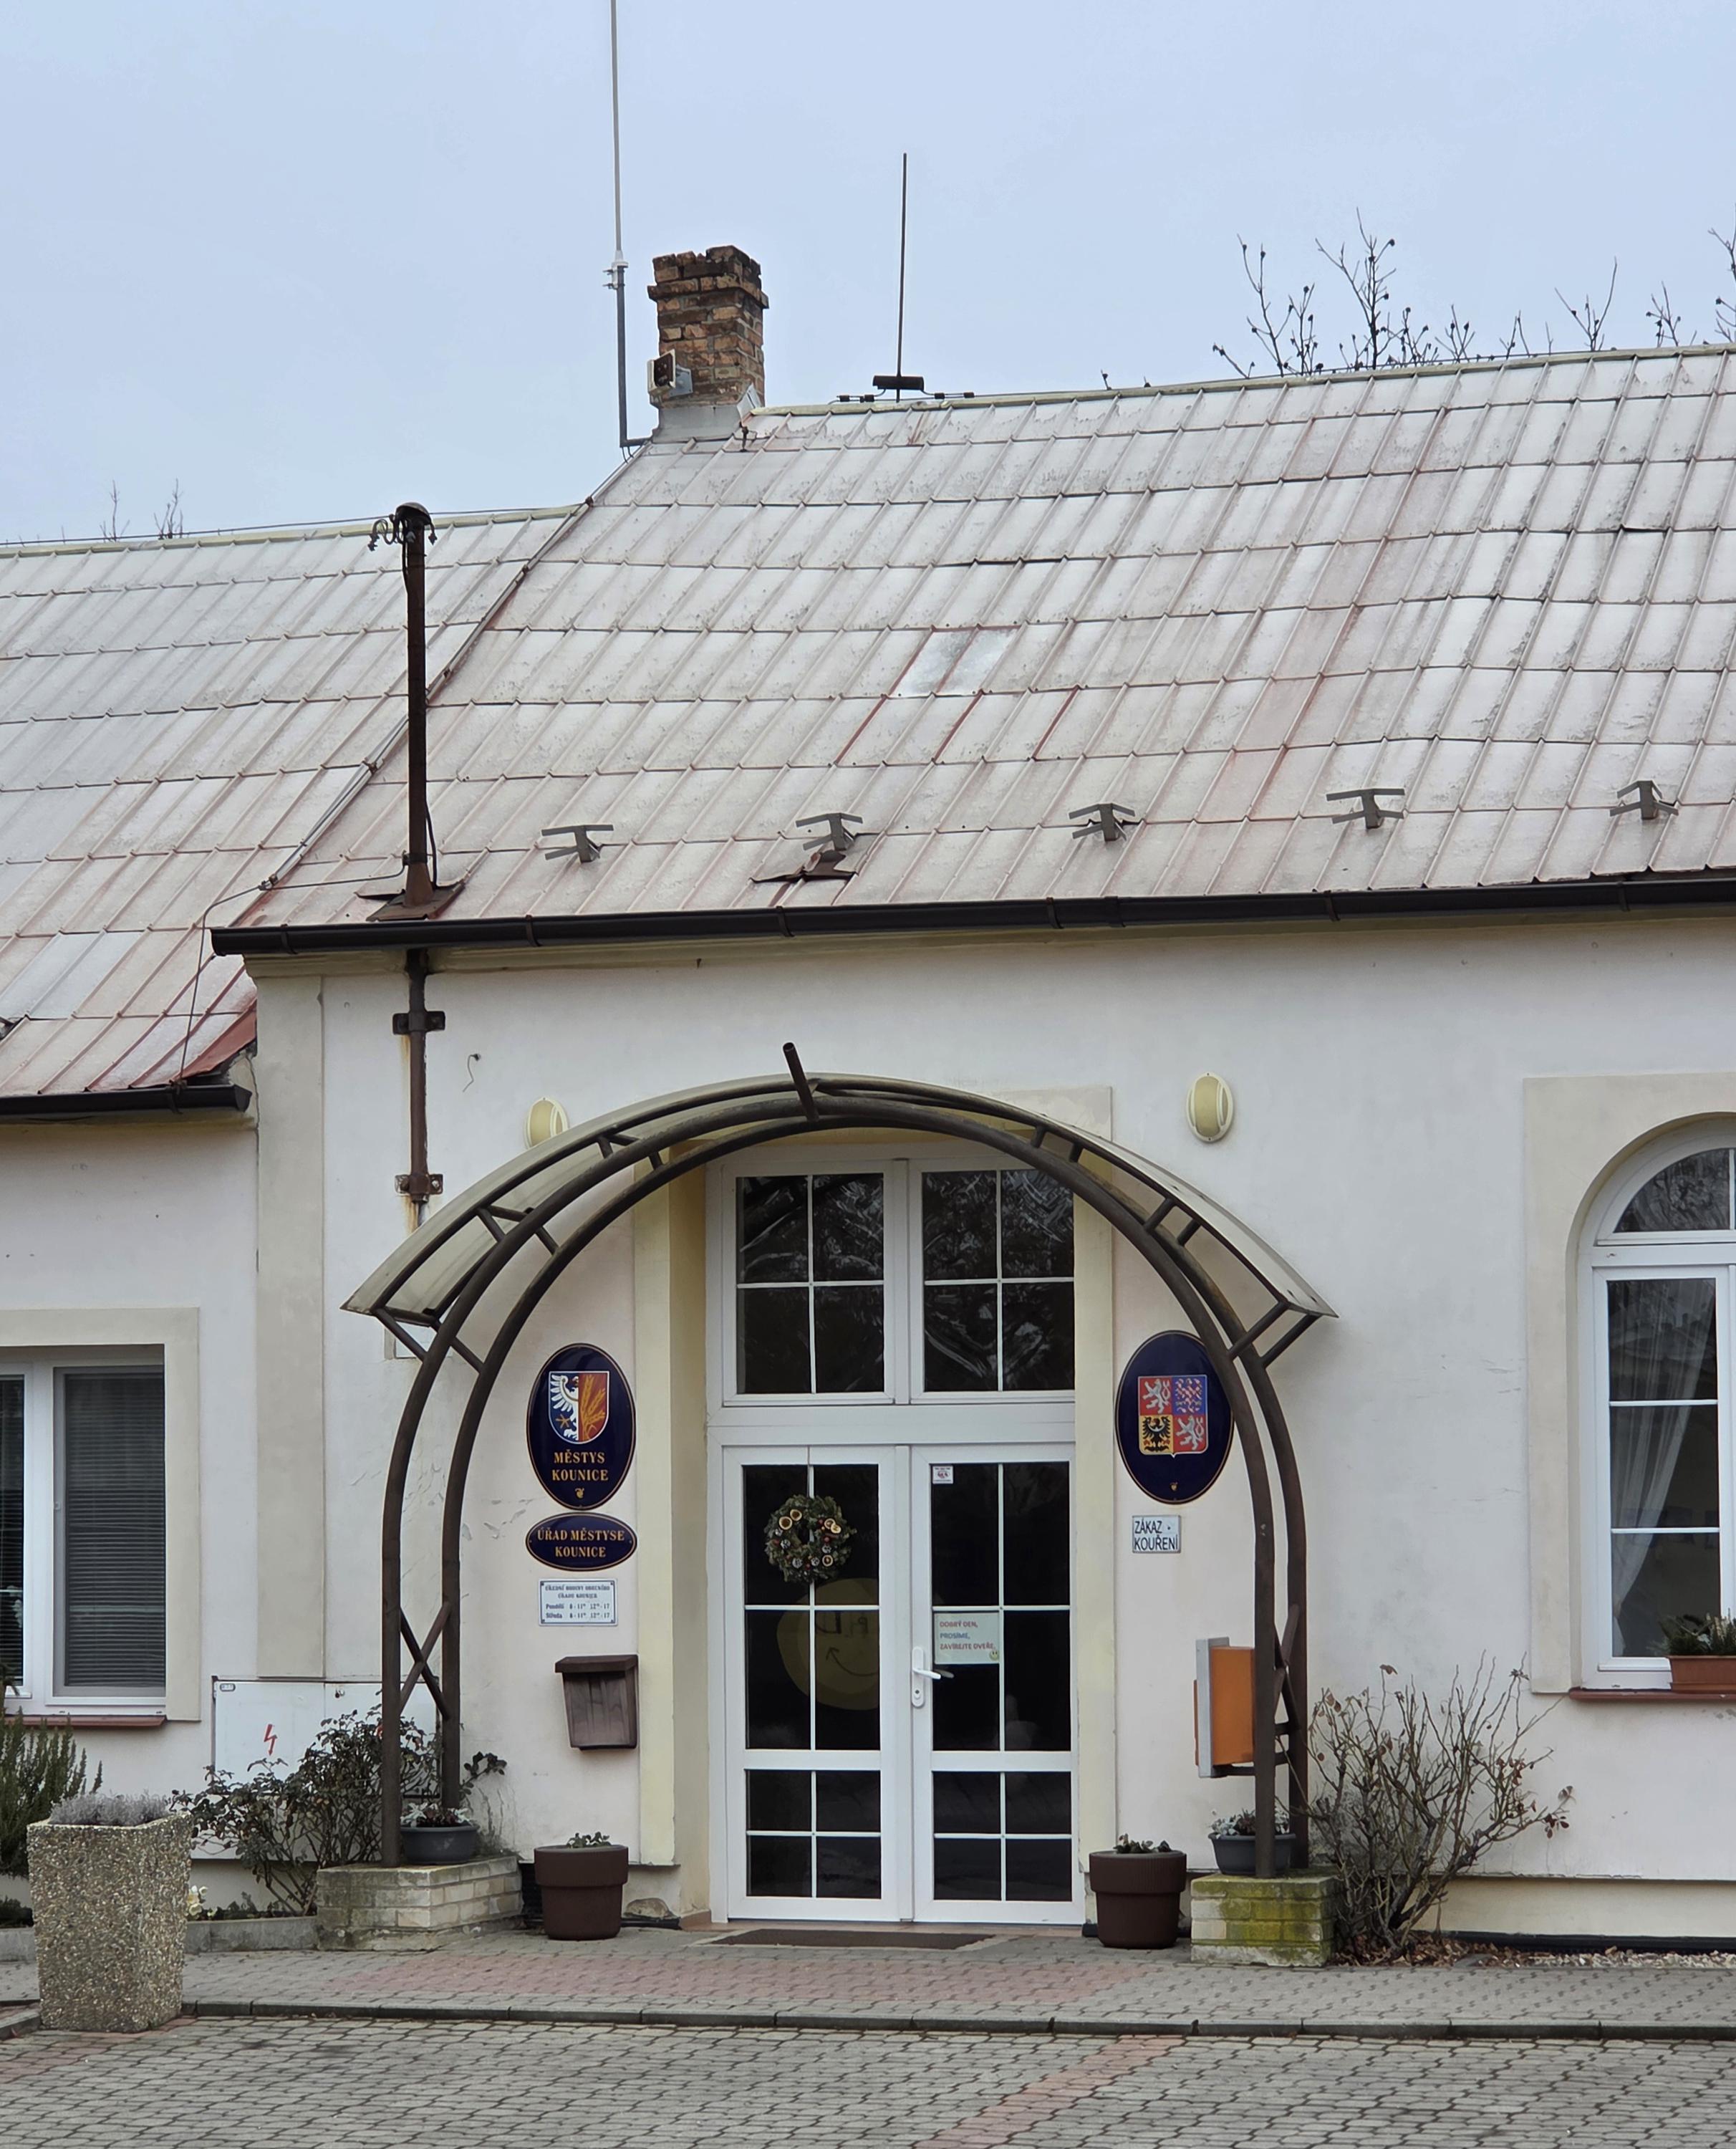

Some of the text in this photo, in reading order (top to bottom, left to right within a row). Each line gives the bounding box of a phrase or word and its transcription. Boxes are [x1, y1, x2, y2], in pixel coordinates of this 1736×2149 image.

[554, 1448, 605, 1463] MĚSTYS
[552, 1469, 609, 1481] KOUNICE
[1134, 1516, 1162, 1534] ZÁKAZ
[537, 1527, 625, 1541] ÚŘAD MĚSTYSE
[1134, 1534, 1178, 1550] KOUŘENÍ
[555, 1547, 606, 1557] KOUNICE
